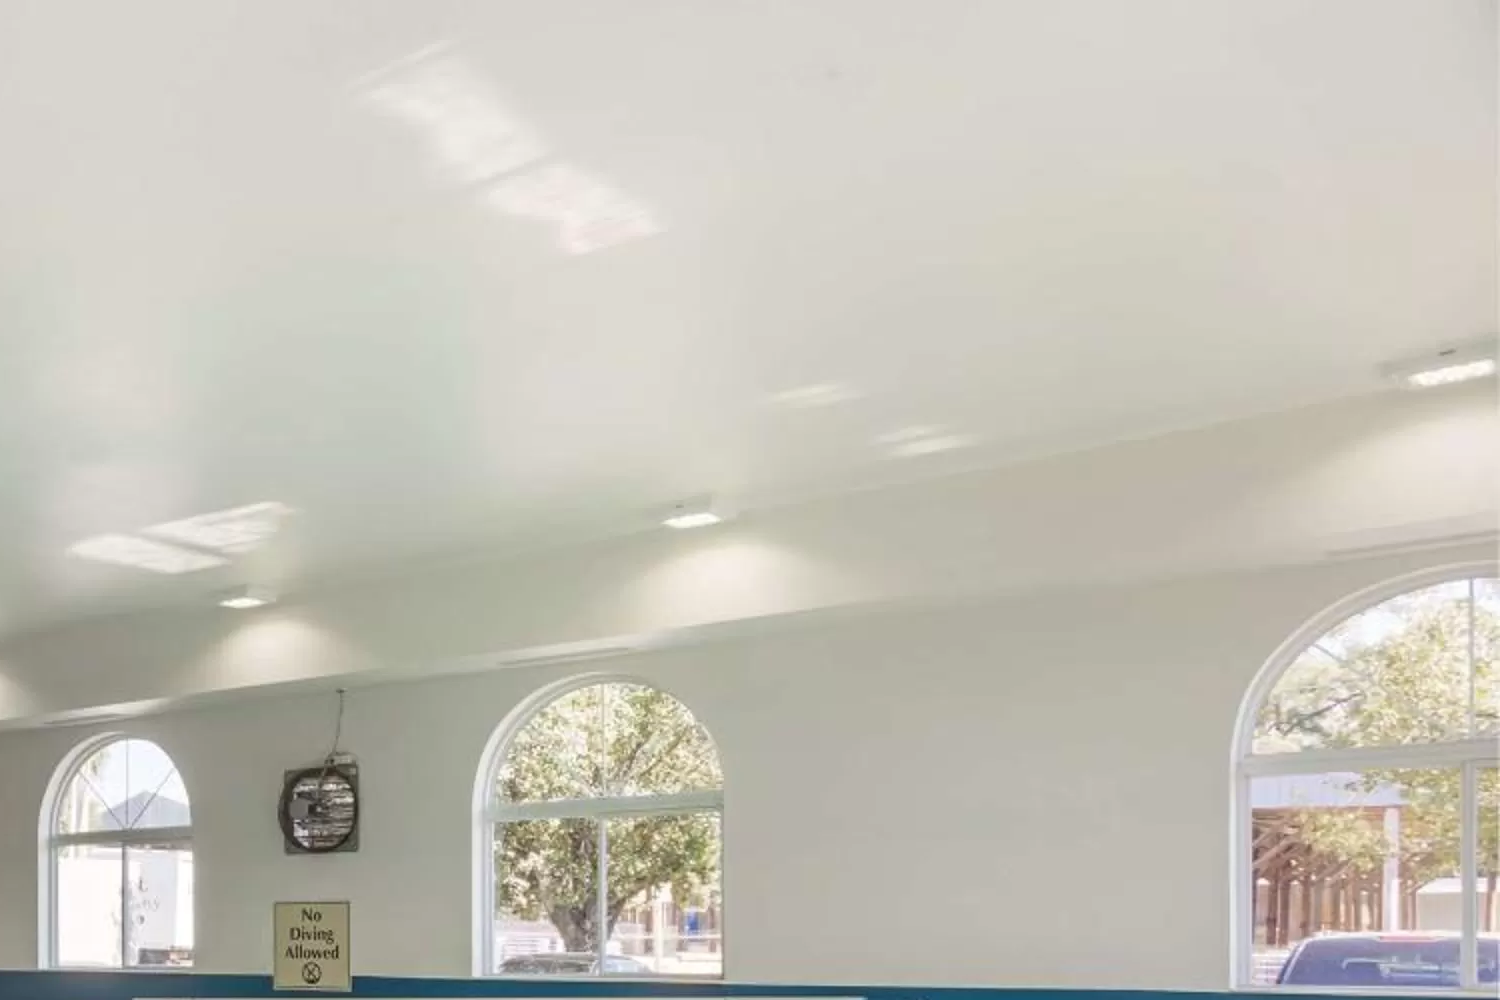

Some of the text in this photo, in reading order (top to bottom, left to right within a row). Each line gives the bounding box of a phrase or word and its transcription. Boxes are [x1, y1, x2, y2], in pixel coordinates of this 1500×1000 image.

[301, 907, 322, 922] No
[289, 926, 335, 944] Diving
[285, 944, 340, 960] Allowed
